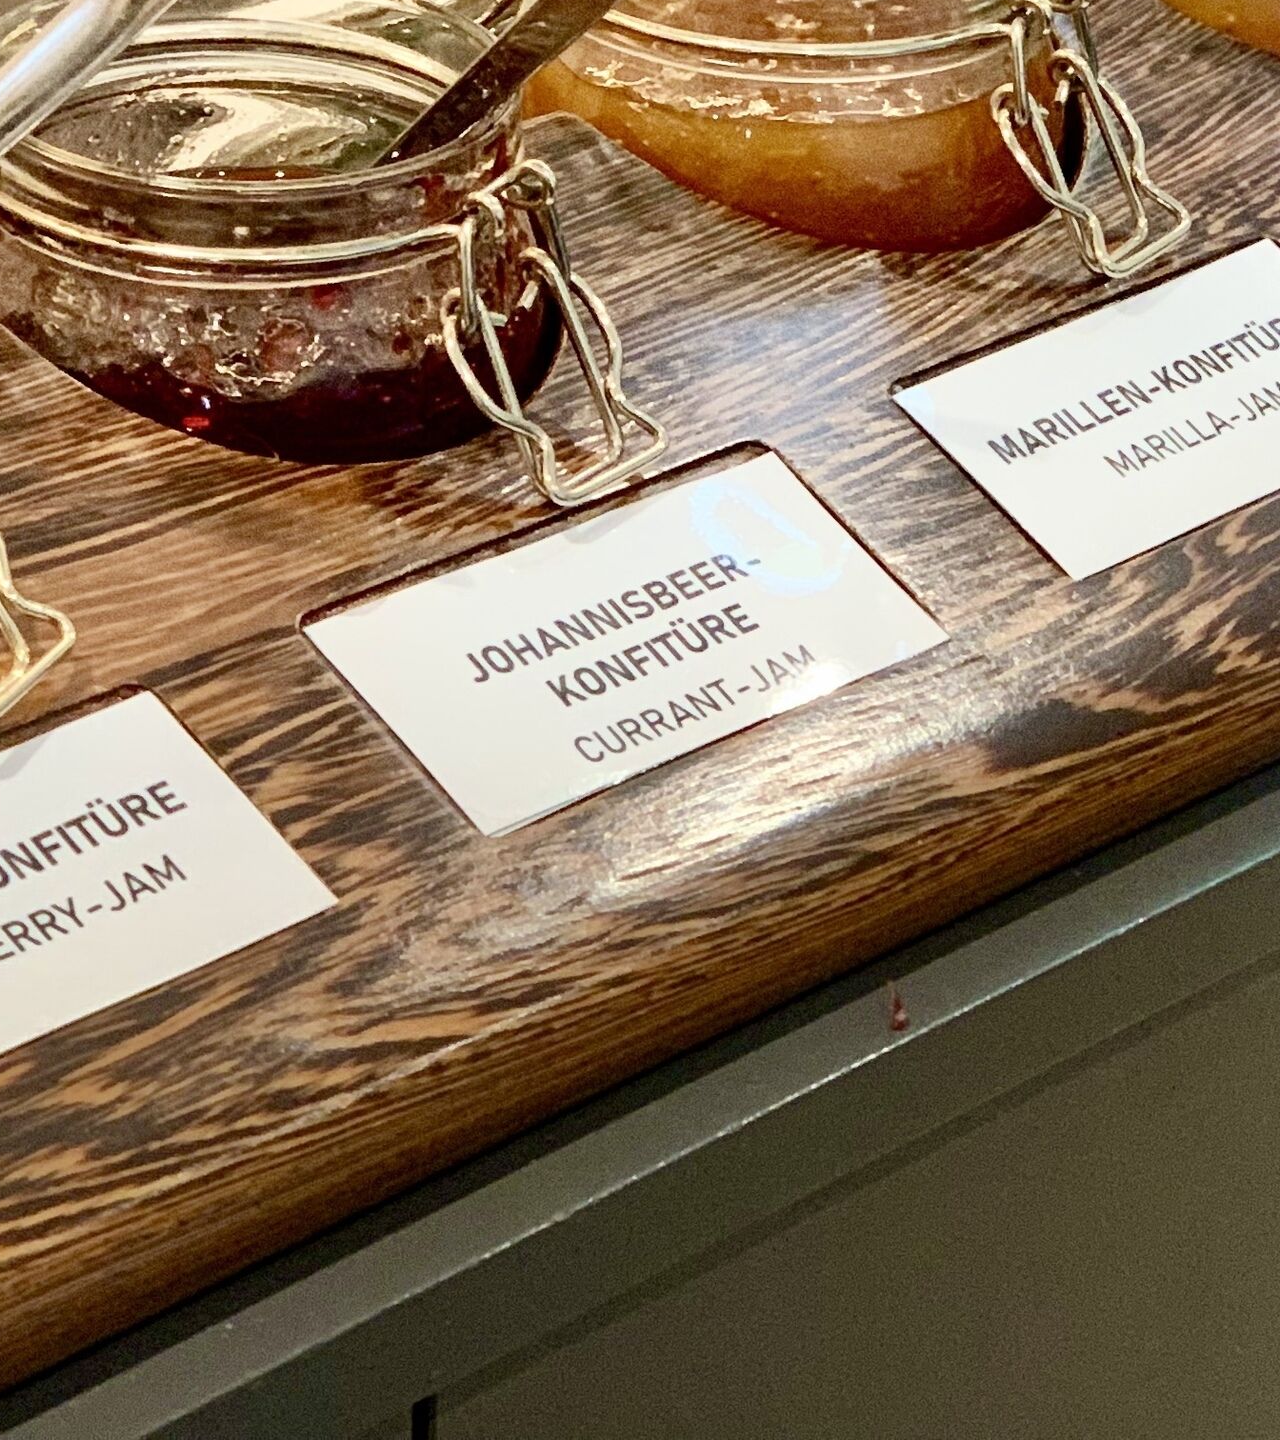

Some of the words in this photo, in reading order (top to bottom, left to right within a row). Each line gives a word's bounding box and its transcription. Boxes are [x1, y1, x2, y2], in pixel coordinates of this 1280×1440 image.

[466, 552, 762, 683] JOHANNISBEER-
[544, 603, 760, 707] KONFITÜRE
[573, 643, 817, 764] CURRANT-JAM
